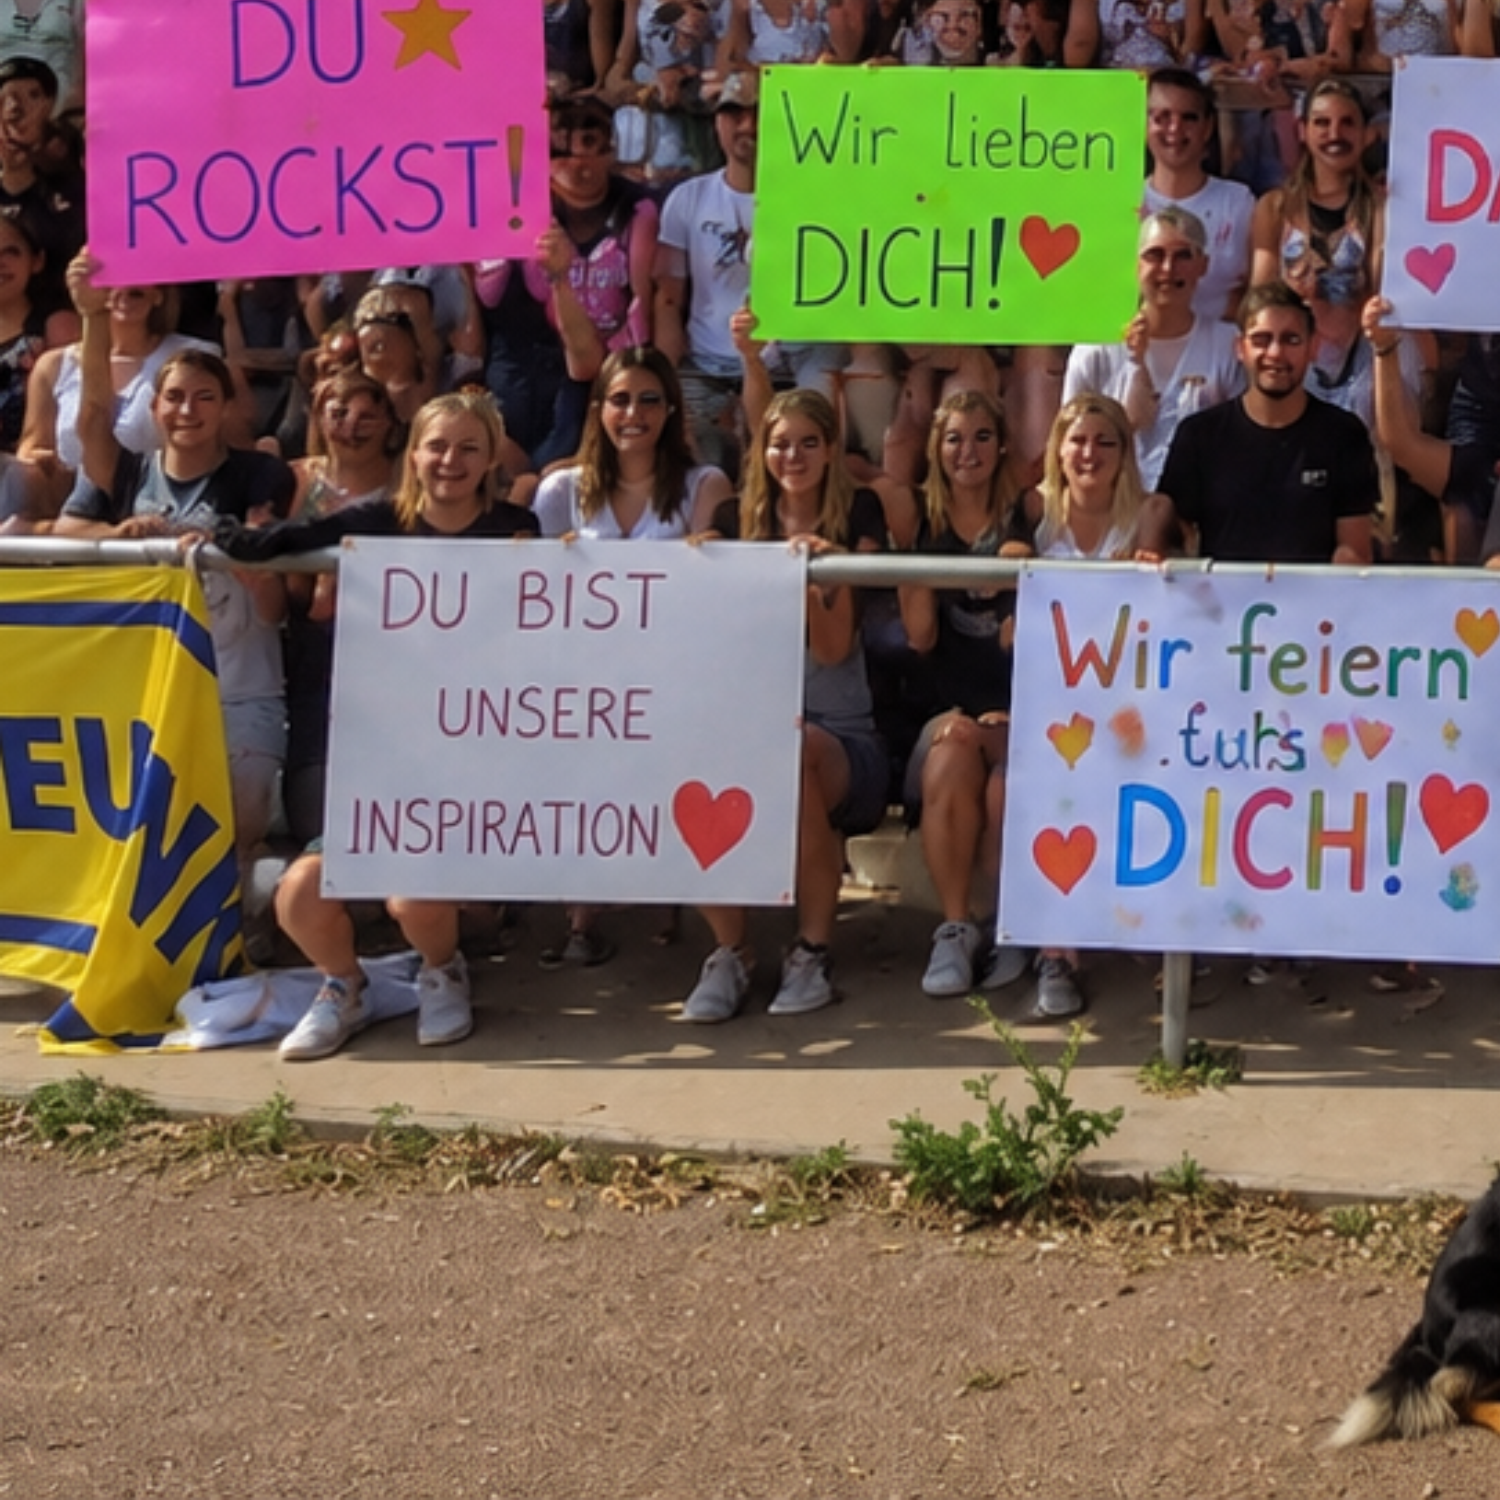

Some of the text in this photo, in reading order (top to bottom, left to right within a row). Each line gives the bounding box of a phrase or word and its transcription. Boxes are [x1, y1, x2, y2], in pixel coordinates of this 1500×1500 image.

[782, 91, 898, 165] Wir
[125, 124, 525, 248] ROCKST!
[793, 218, 1006, 310] DICH!
[381, 568, 667, 632] DU BIST
[1051, 601, 1469, 701] Wir feiern
[439, 687, 653, 741] UNSERE
[346, 799, 660, 858] INSPIRATION
[1115, 782, 1407, 896] DICH!
